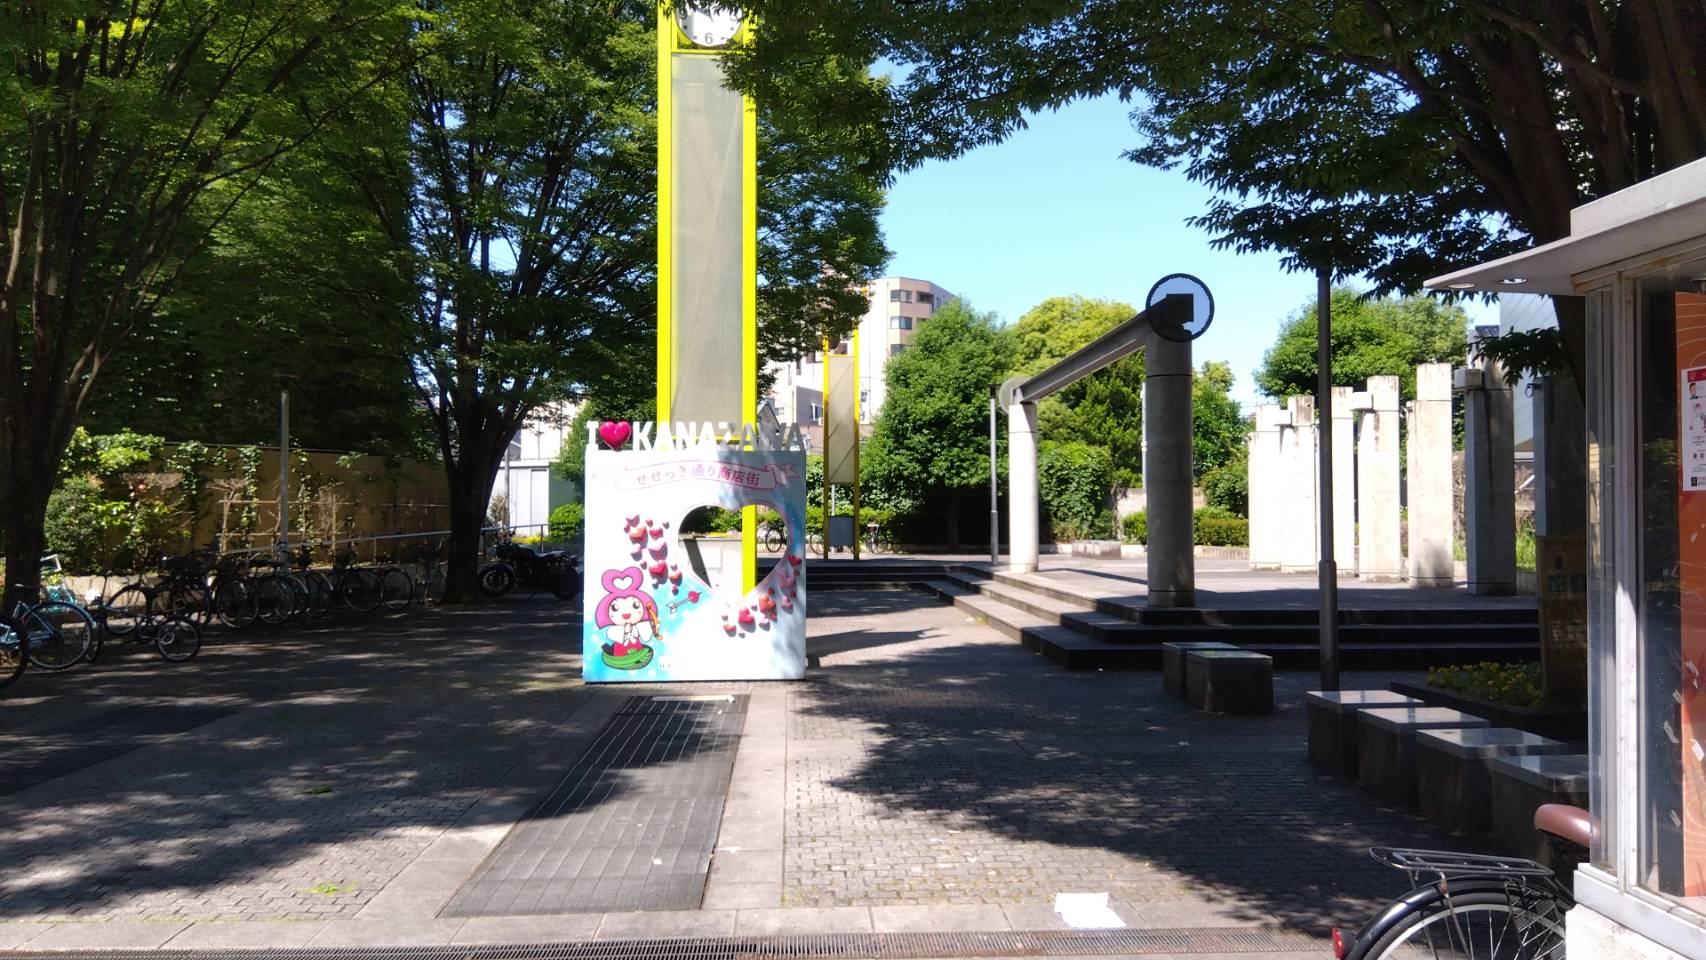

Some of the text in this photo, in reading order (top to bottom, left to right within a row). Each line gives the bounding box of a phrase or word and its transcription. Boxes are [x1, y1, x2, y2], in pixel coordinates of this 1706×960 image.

[704, 32, 714, 44] 6
[586, 421, 806, 451] I KANAZAWA
